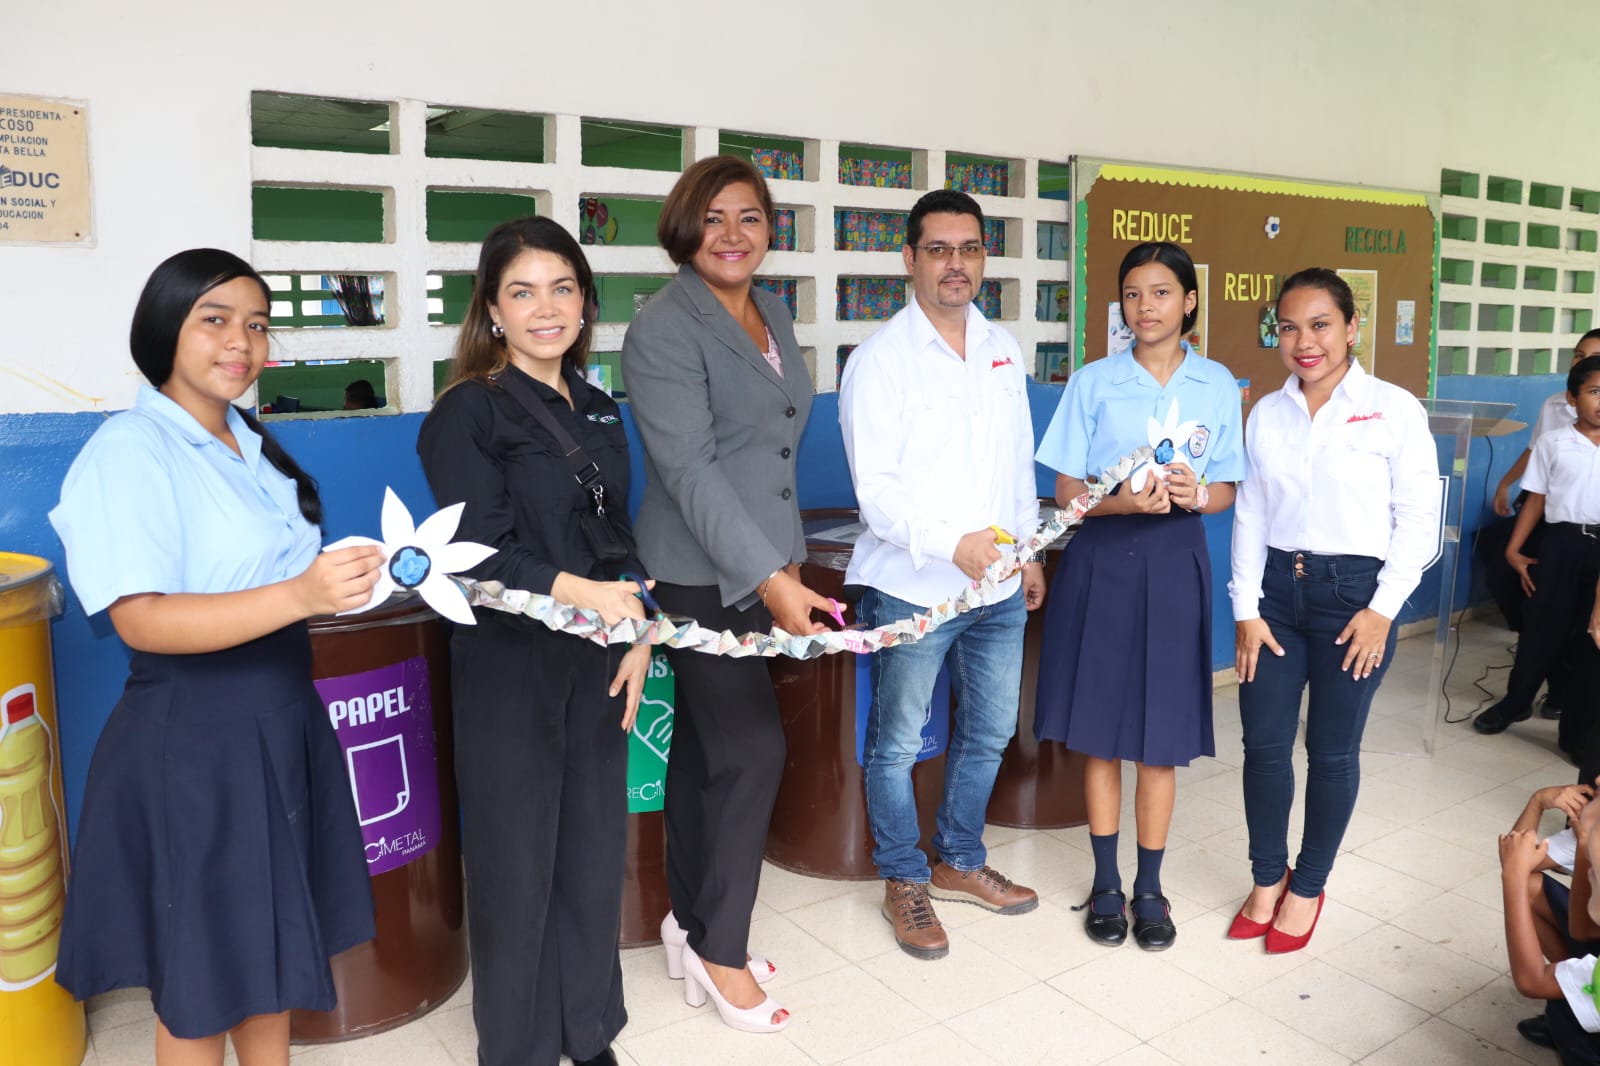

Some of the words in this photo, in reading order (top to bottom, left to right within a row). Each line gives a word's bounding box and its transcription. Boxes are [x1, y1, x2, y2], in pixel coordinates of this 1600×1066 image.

[0, 107, 61, 121] PRESIDENTA
[13, 146, 46, 157] BELLA
[11, 197, 47, 208] SOCIAL
[50, 199, 56, 208] Y
[1112, 208, 1193, 244] REDUCE
[1345, 226, 1407, 255] RECICLA
[1224, 272, 1285, 302] REUTI
[328, 685, 411, 730] PAPEL
